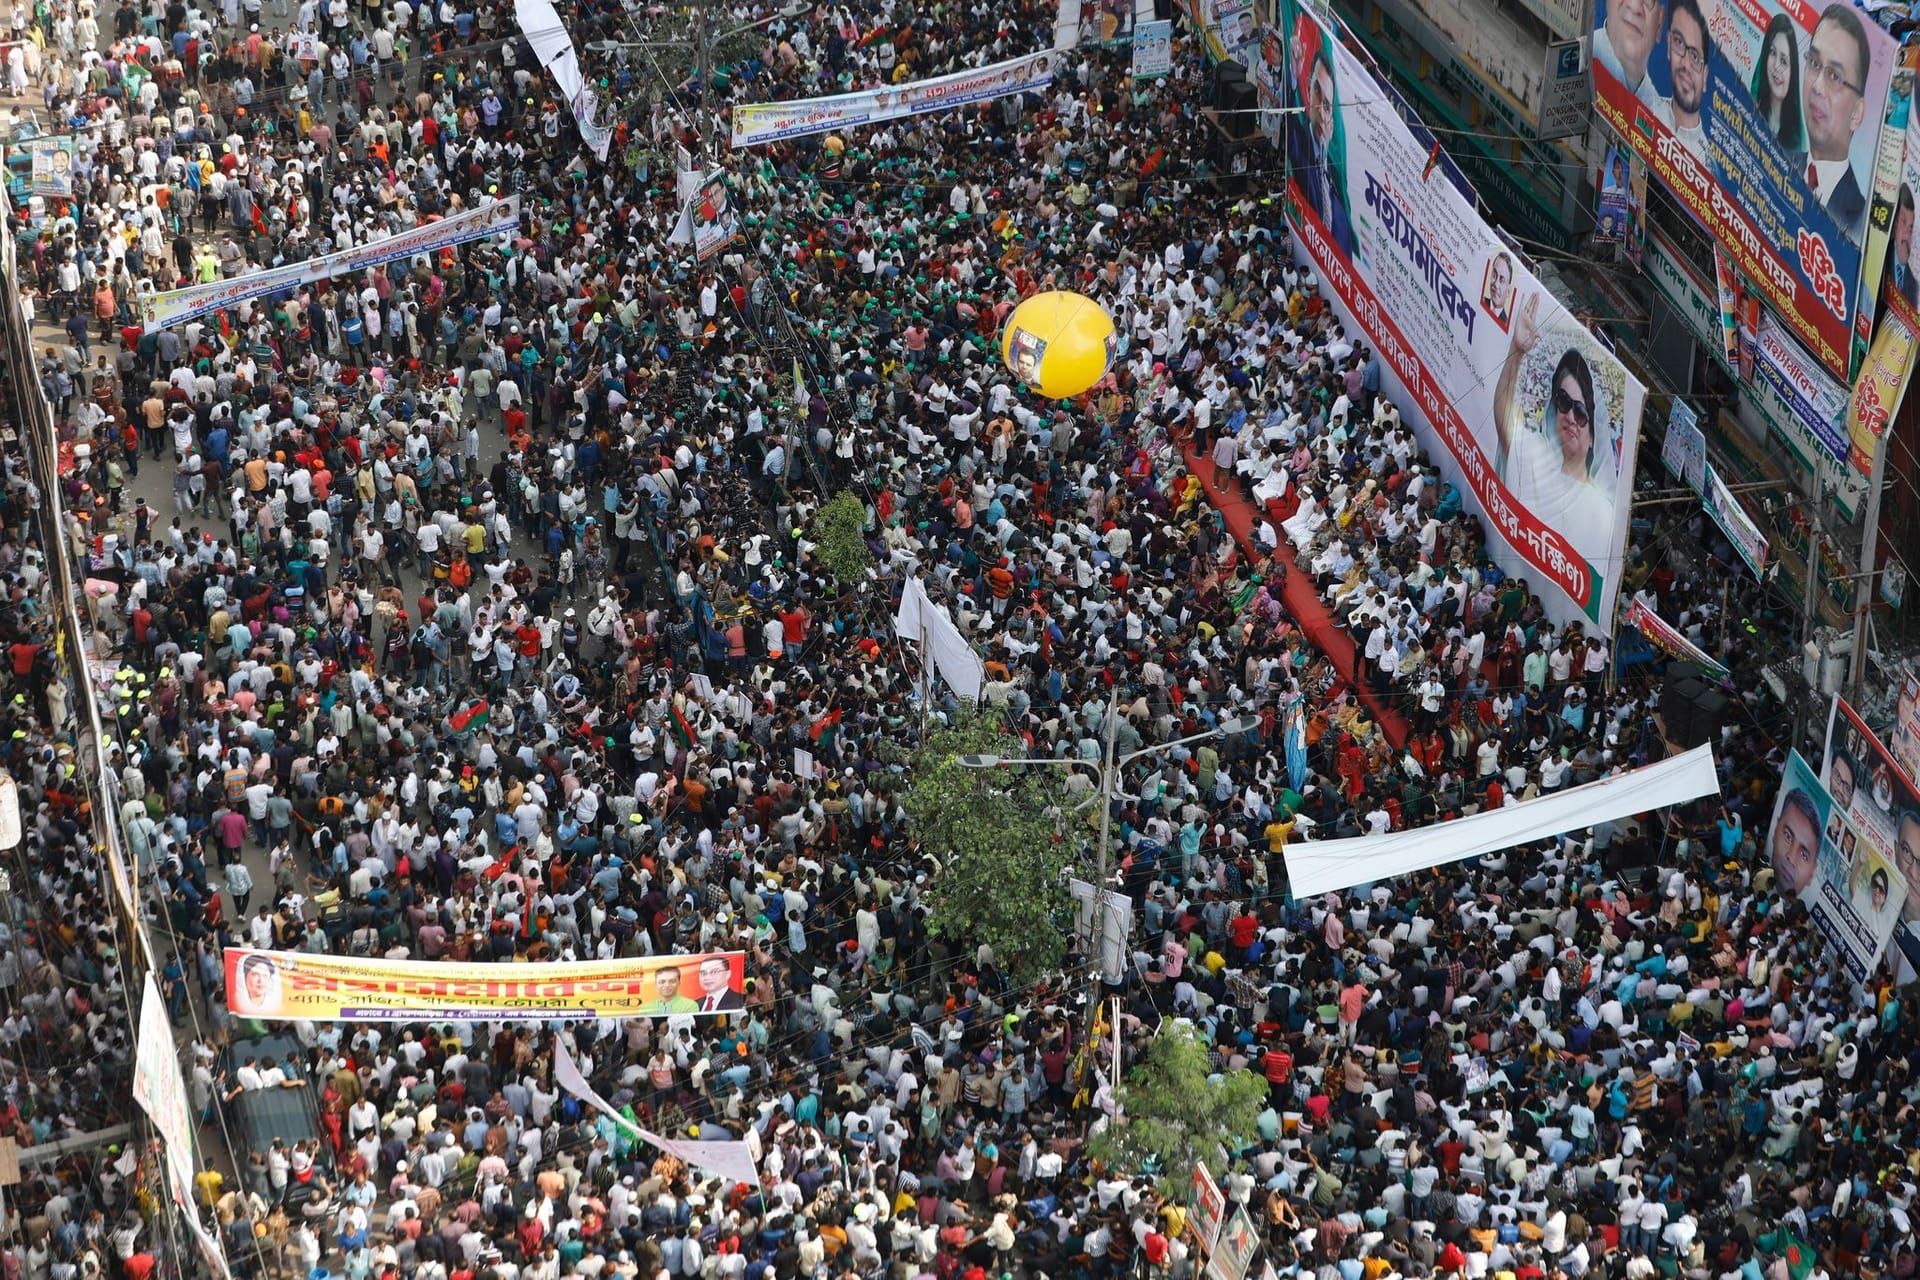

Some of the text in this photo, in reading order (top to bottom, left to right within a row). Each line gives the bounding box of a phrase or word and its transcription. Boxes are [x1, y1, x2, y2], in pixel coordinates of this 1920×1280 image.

[1545, 101, 1587, 118] CONSUMERS
[1551, 113, 1579, 128] LIMITED
[1553, 79, 1585, 94] ELECTRO
[1393, 188, 1415, 224] দফা
[1419, 219, 1456, 277] দাবিতে
[1475, 156, 1504, 193] PUBALI
[1505, 184, 1528, 216] BANK
[1529, 206, 1566, 249] LIMITED
[1657, 128, 1710, 200] রবিউল
[1711, 182, 1762, 260] ইসলাম
[1762, 247, 1797, 301] নয়ন
[1364, 169, 1477, 345] মহাসমাবেশ
[1655, 156, 1670, 180] ঢাকা
[1670, 171, 1698, 209] মহানগর
[1719, 225, 1726, 238] ও
[1744, 252, 1776, 298] বাংলাদেশ
[1775, 293, 1820, 346] জাতীয়তাবাদী
[1820, 337, 1844, 373] যুবদল
[1798, 228, 1847, 321] মুক্তি চাই
[1304, 216, 1353, 299] বাংলাদেশ
[1353, 284, 1420, 394] জাতীয়তাবাদী
[1423, 384, 1484, 489] দল-বিএনপি
[1486, 479, 1584, 599] (উত্তর-দক্ষিণ)
[289, 975, 641, 998] মহাসমাবেশ
[504, 997, 567, 1008] চৌধুরী
